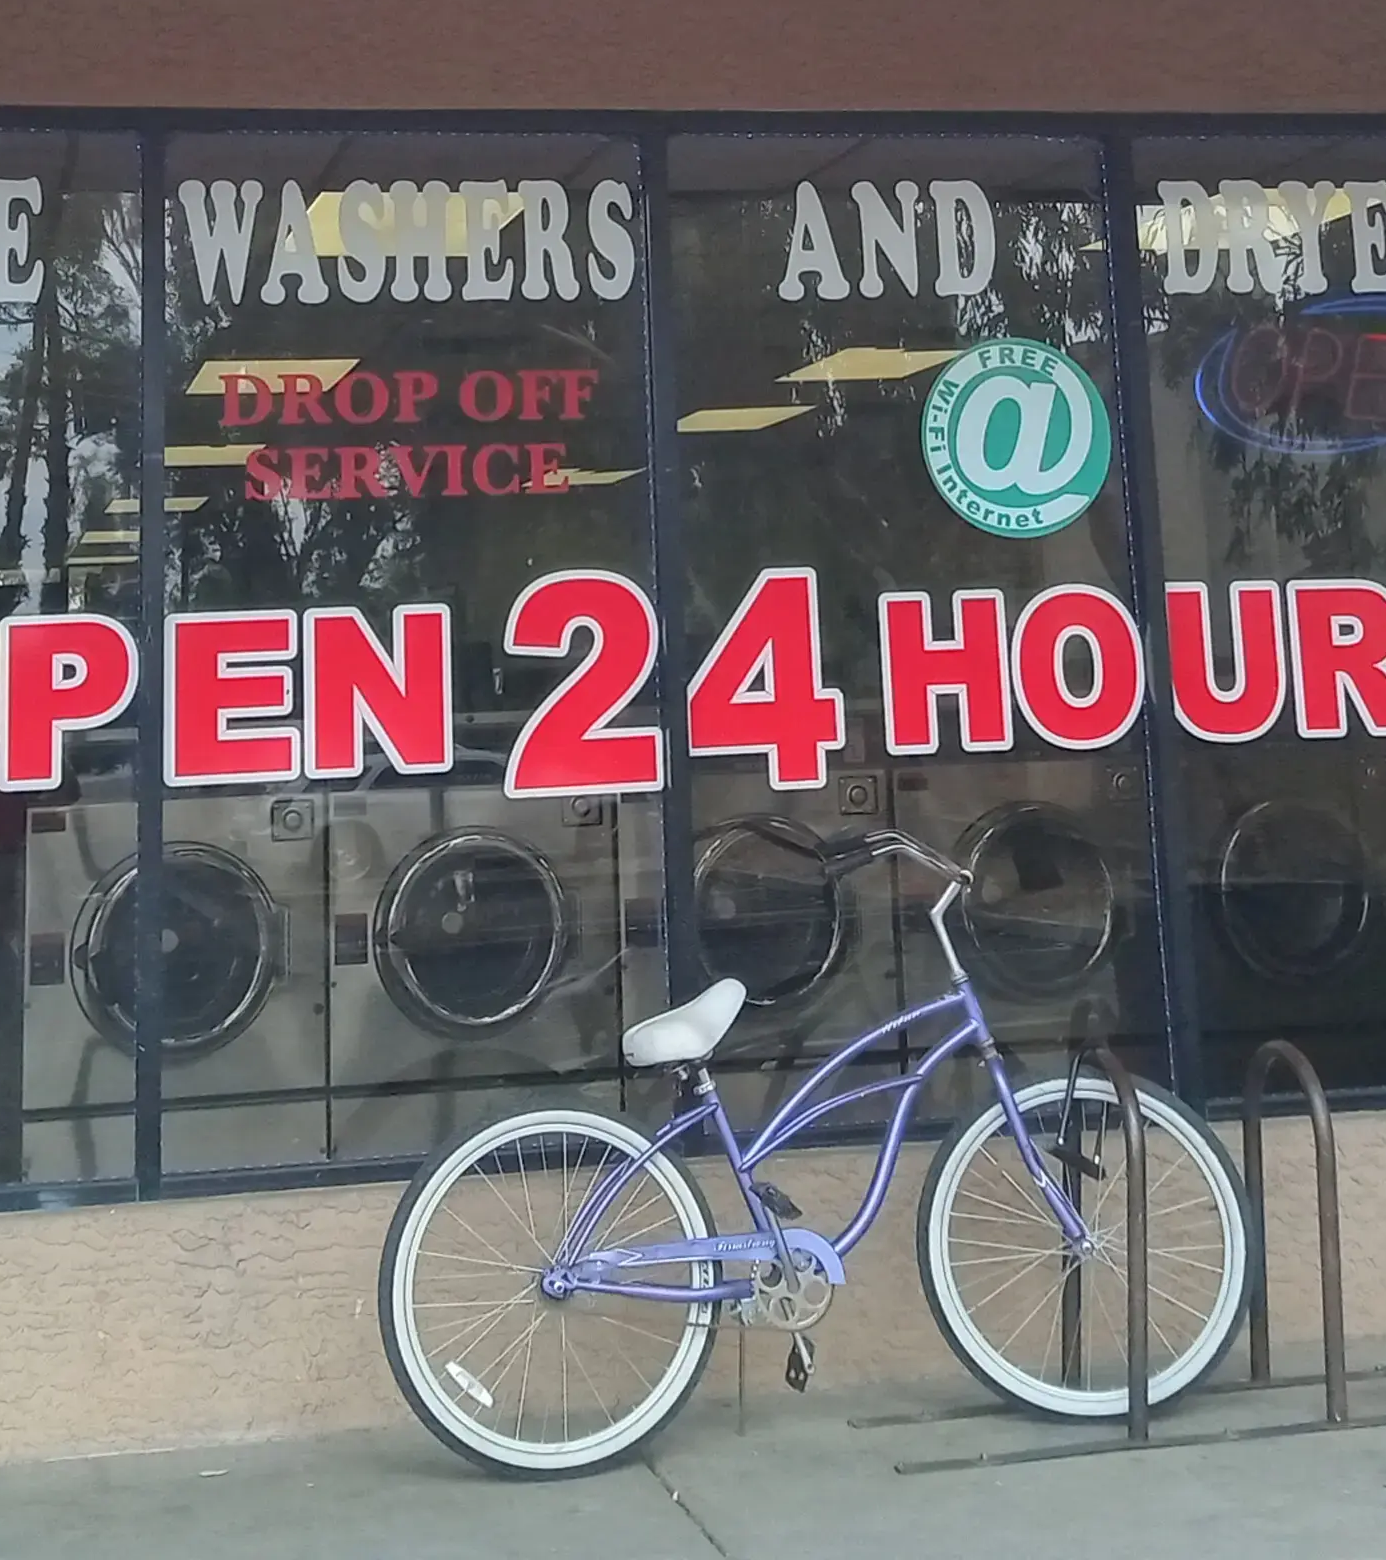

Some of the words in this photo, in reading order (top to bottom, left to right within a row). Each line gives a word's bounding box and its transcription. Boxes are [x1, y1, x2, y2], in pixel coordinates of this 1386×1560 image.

[178, 178, 636, 306] WASHERS
[778, 178, 996, 302] AND
[977, 346, 1059, 377] FREE
[217, 369, 438, 429] DROP
[456, 368, 600, 422] OFF
[928, 378, 961, 453] Wi-Fi
[243, 442, 572, 502] SERVICE
[936, 463, 1044, 528] Internet
[502, 566, 846, 798] 24
